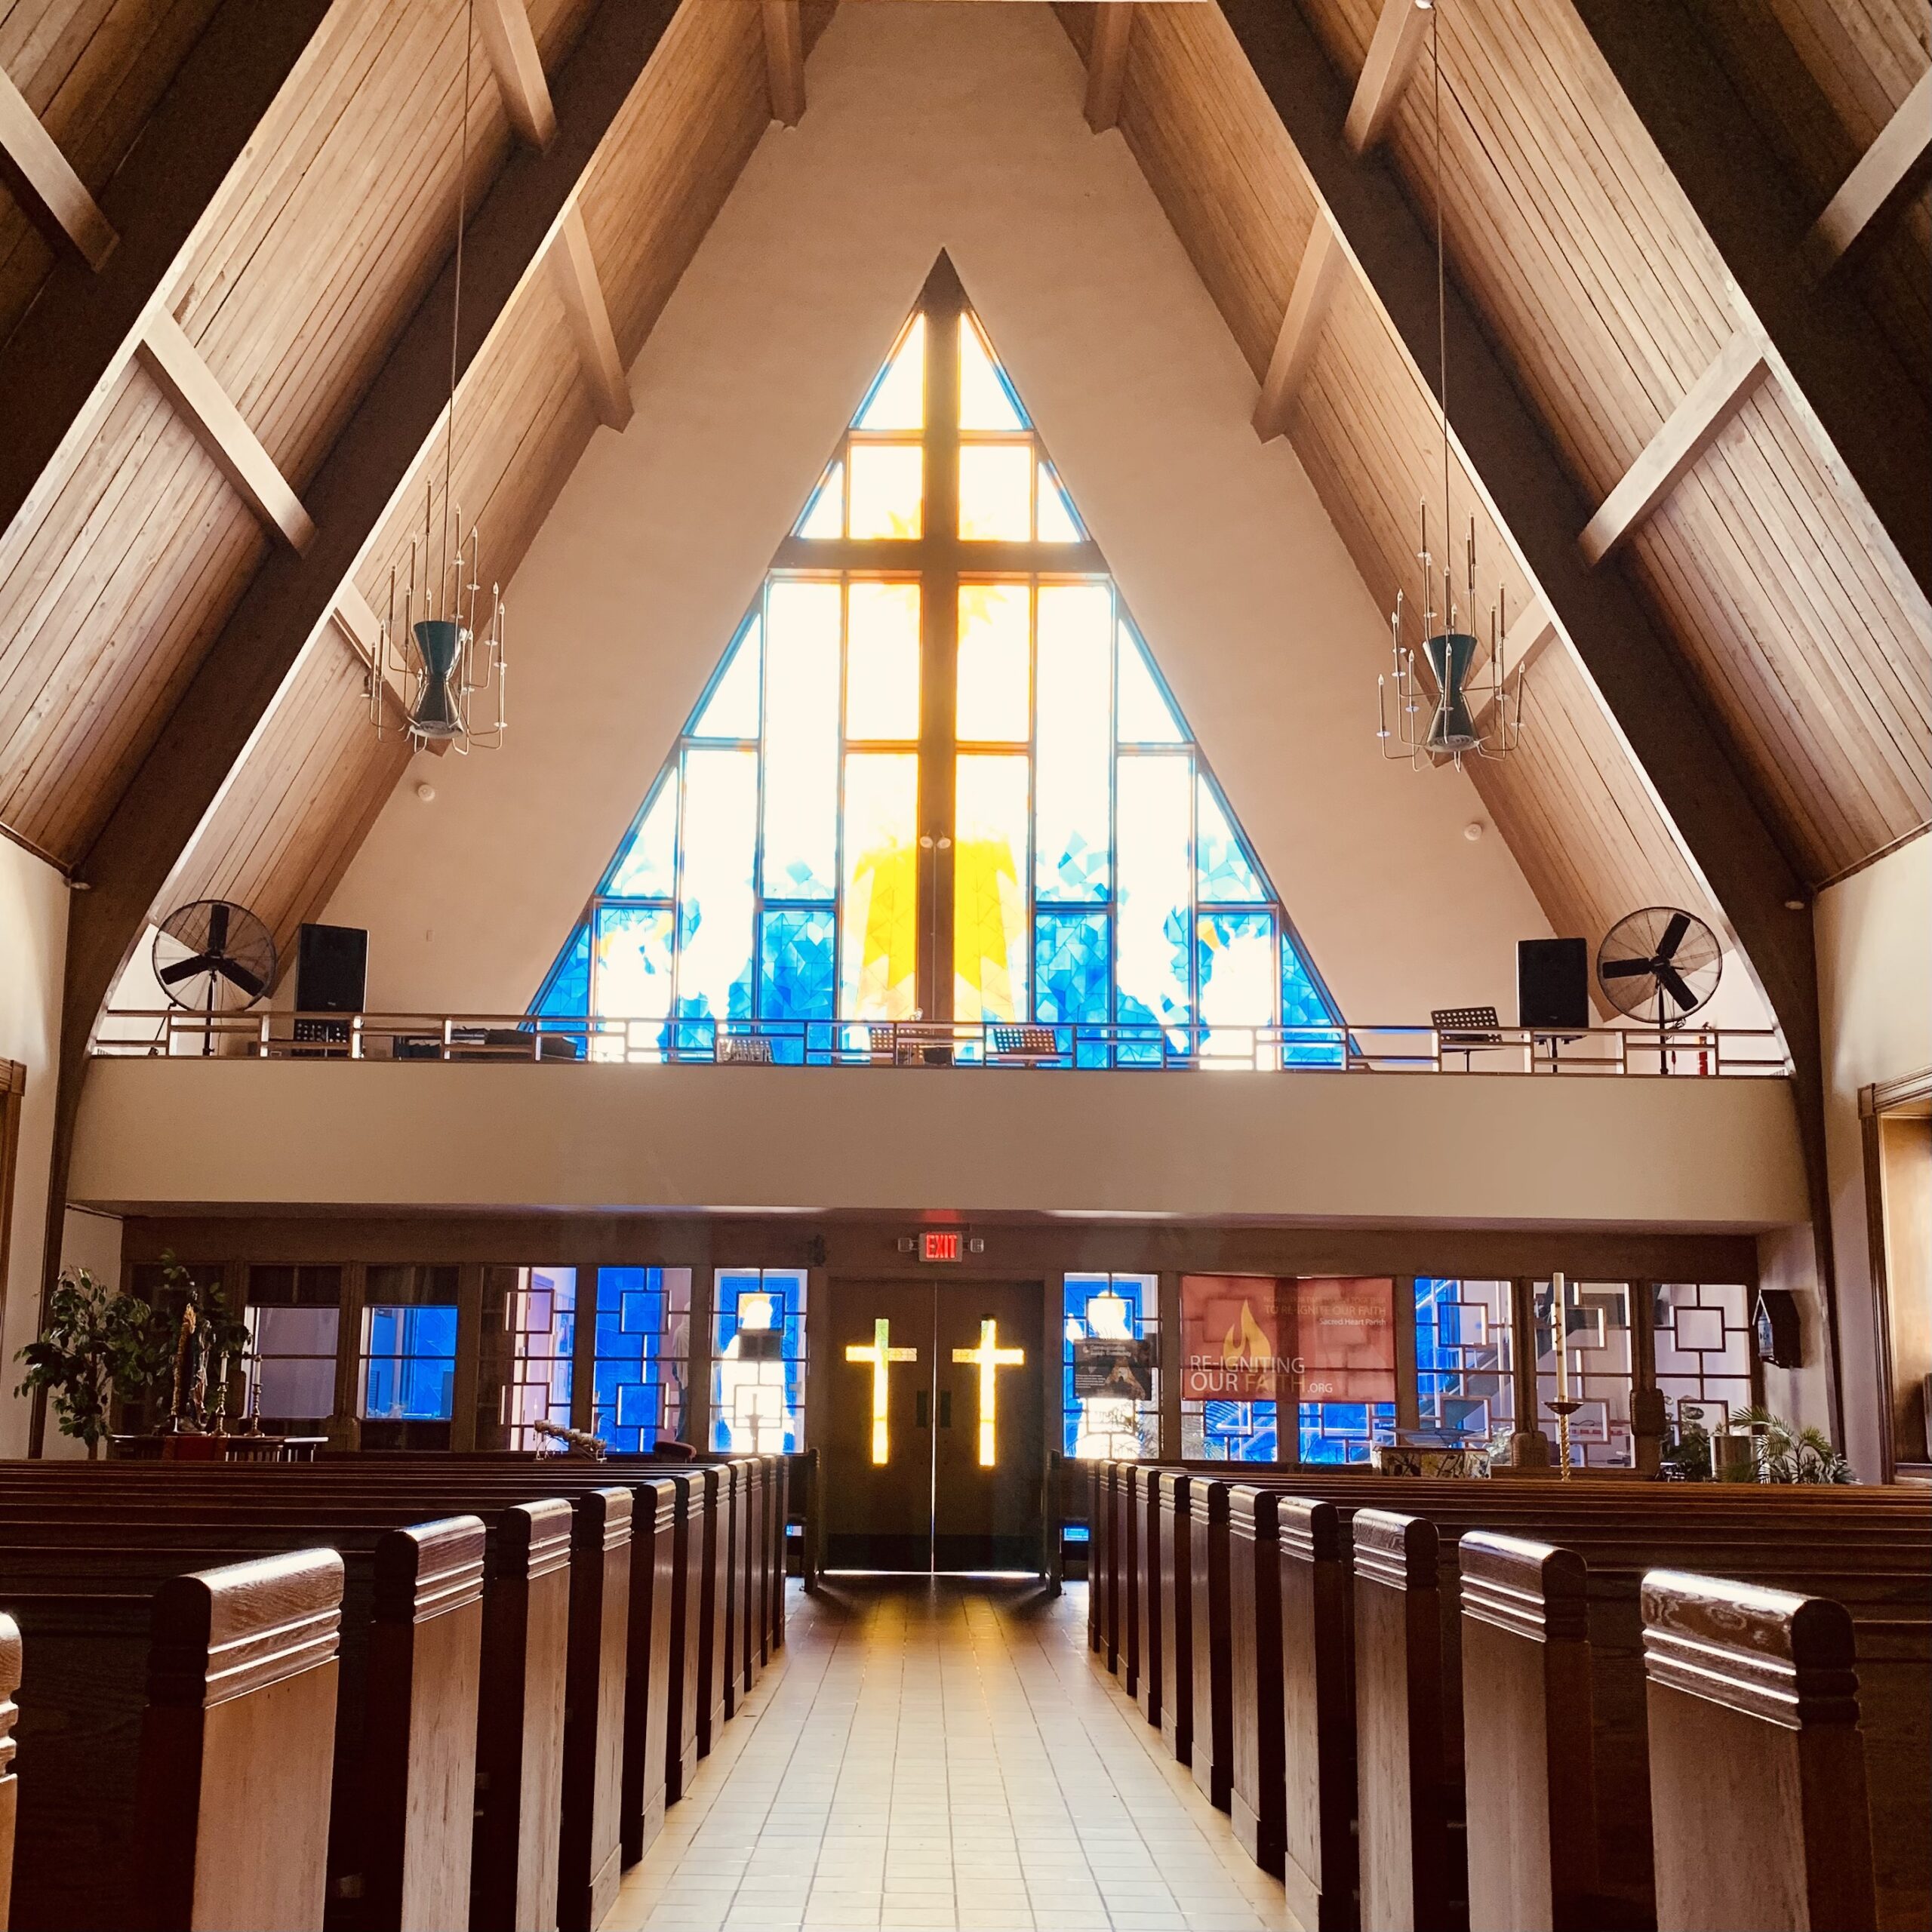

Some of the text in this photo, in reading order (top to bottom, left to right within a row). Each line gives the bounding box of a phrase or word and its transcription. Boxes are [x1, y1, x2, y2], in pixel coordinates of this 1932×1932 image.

[926, 1235, 957, 1258] EXIT
[1263, 1305, 1278, 1315] TO
[1332, 1306, 1355, 1315] OUR
[1358, 1306, 1386, 1317] FAITH
[1189, 1355, 1305, 1374] RE-IGNITING
[1190, 1371, 1238, 1392] OUR
